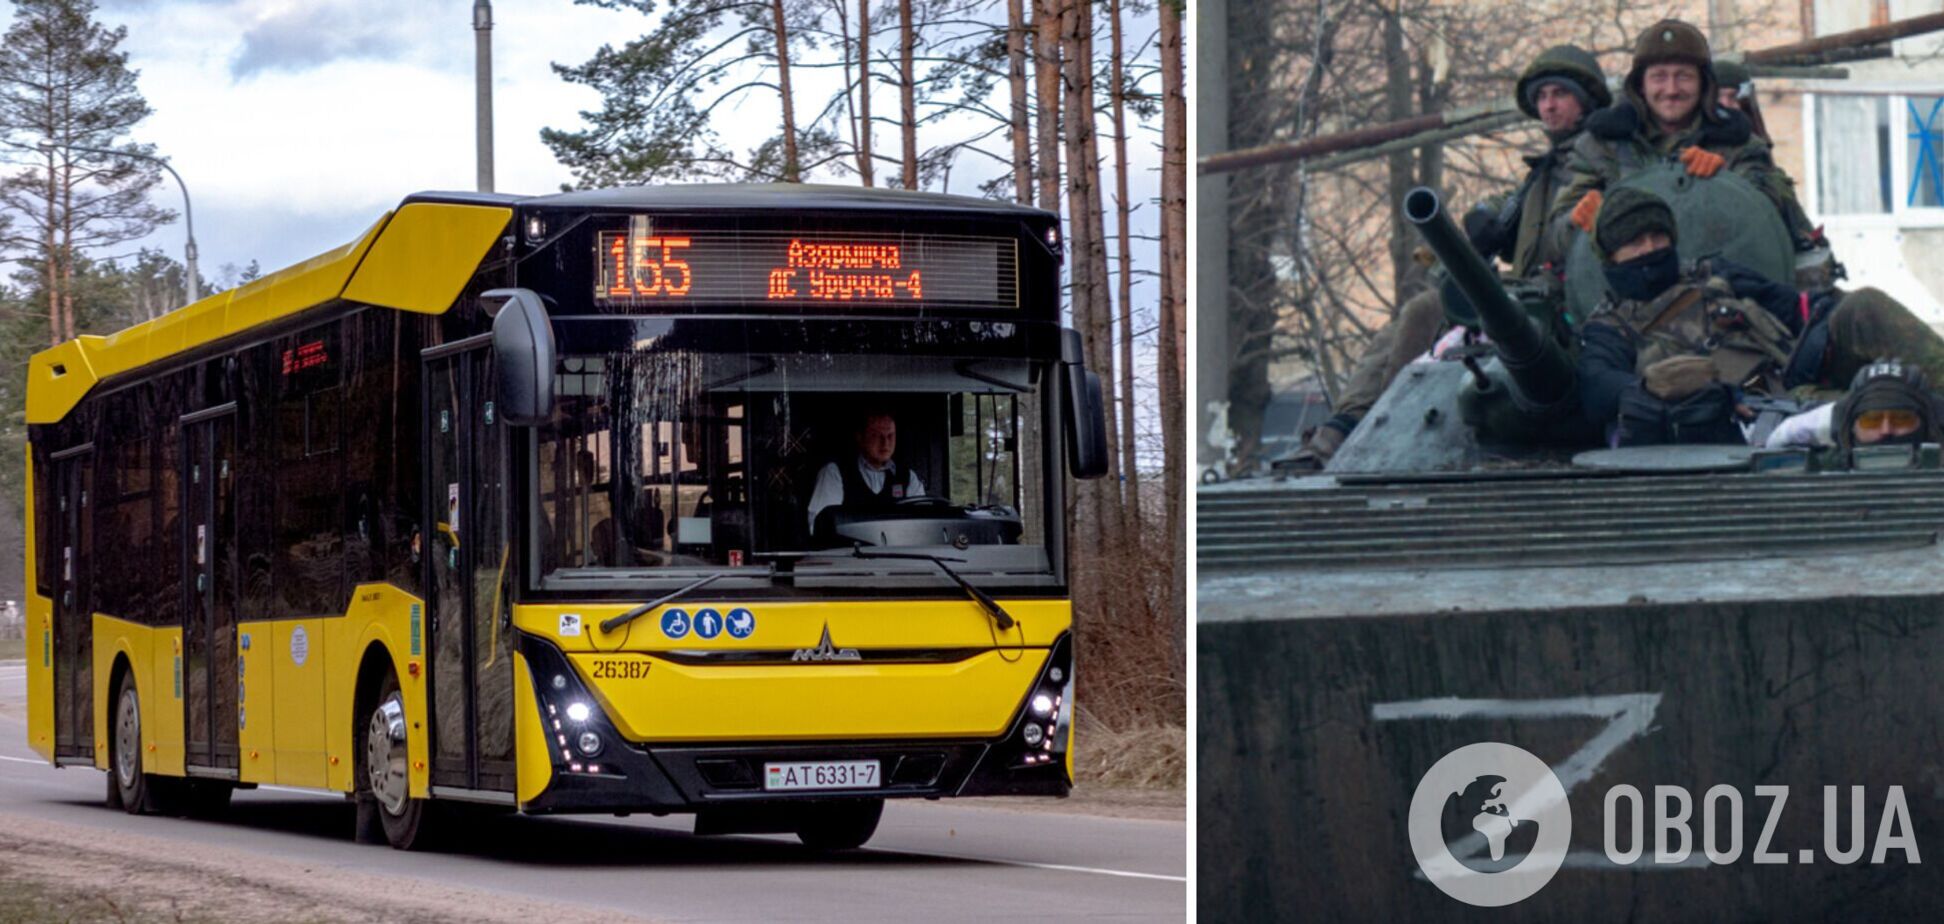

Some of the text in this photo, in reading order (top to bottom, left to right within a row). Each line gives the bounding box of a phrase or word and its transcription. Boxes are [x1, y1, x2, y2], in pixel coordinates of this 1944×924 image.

[788, 239, 901, 269] Азярышча
[768, 268, 922, 299] ДС Уручча-4
[593, 660, 652, 679] 26387
[1372, 693, 1710, 880] Z
